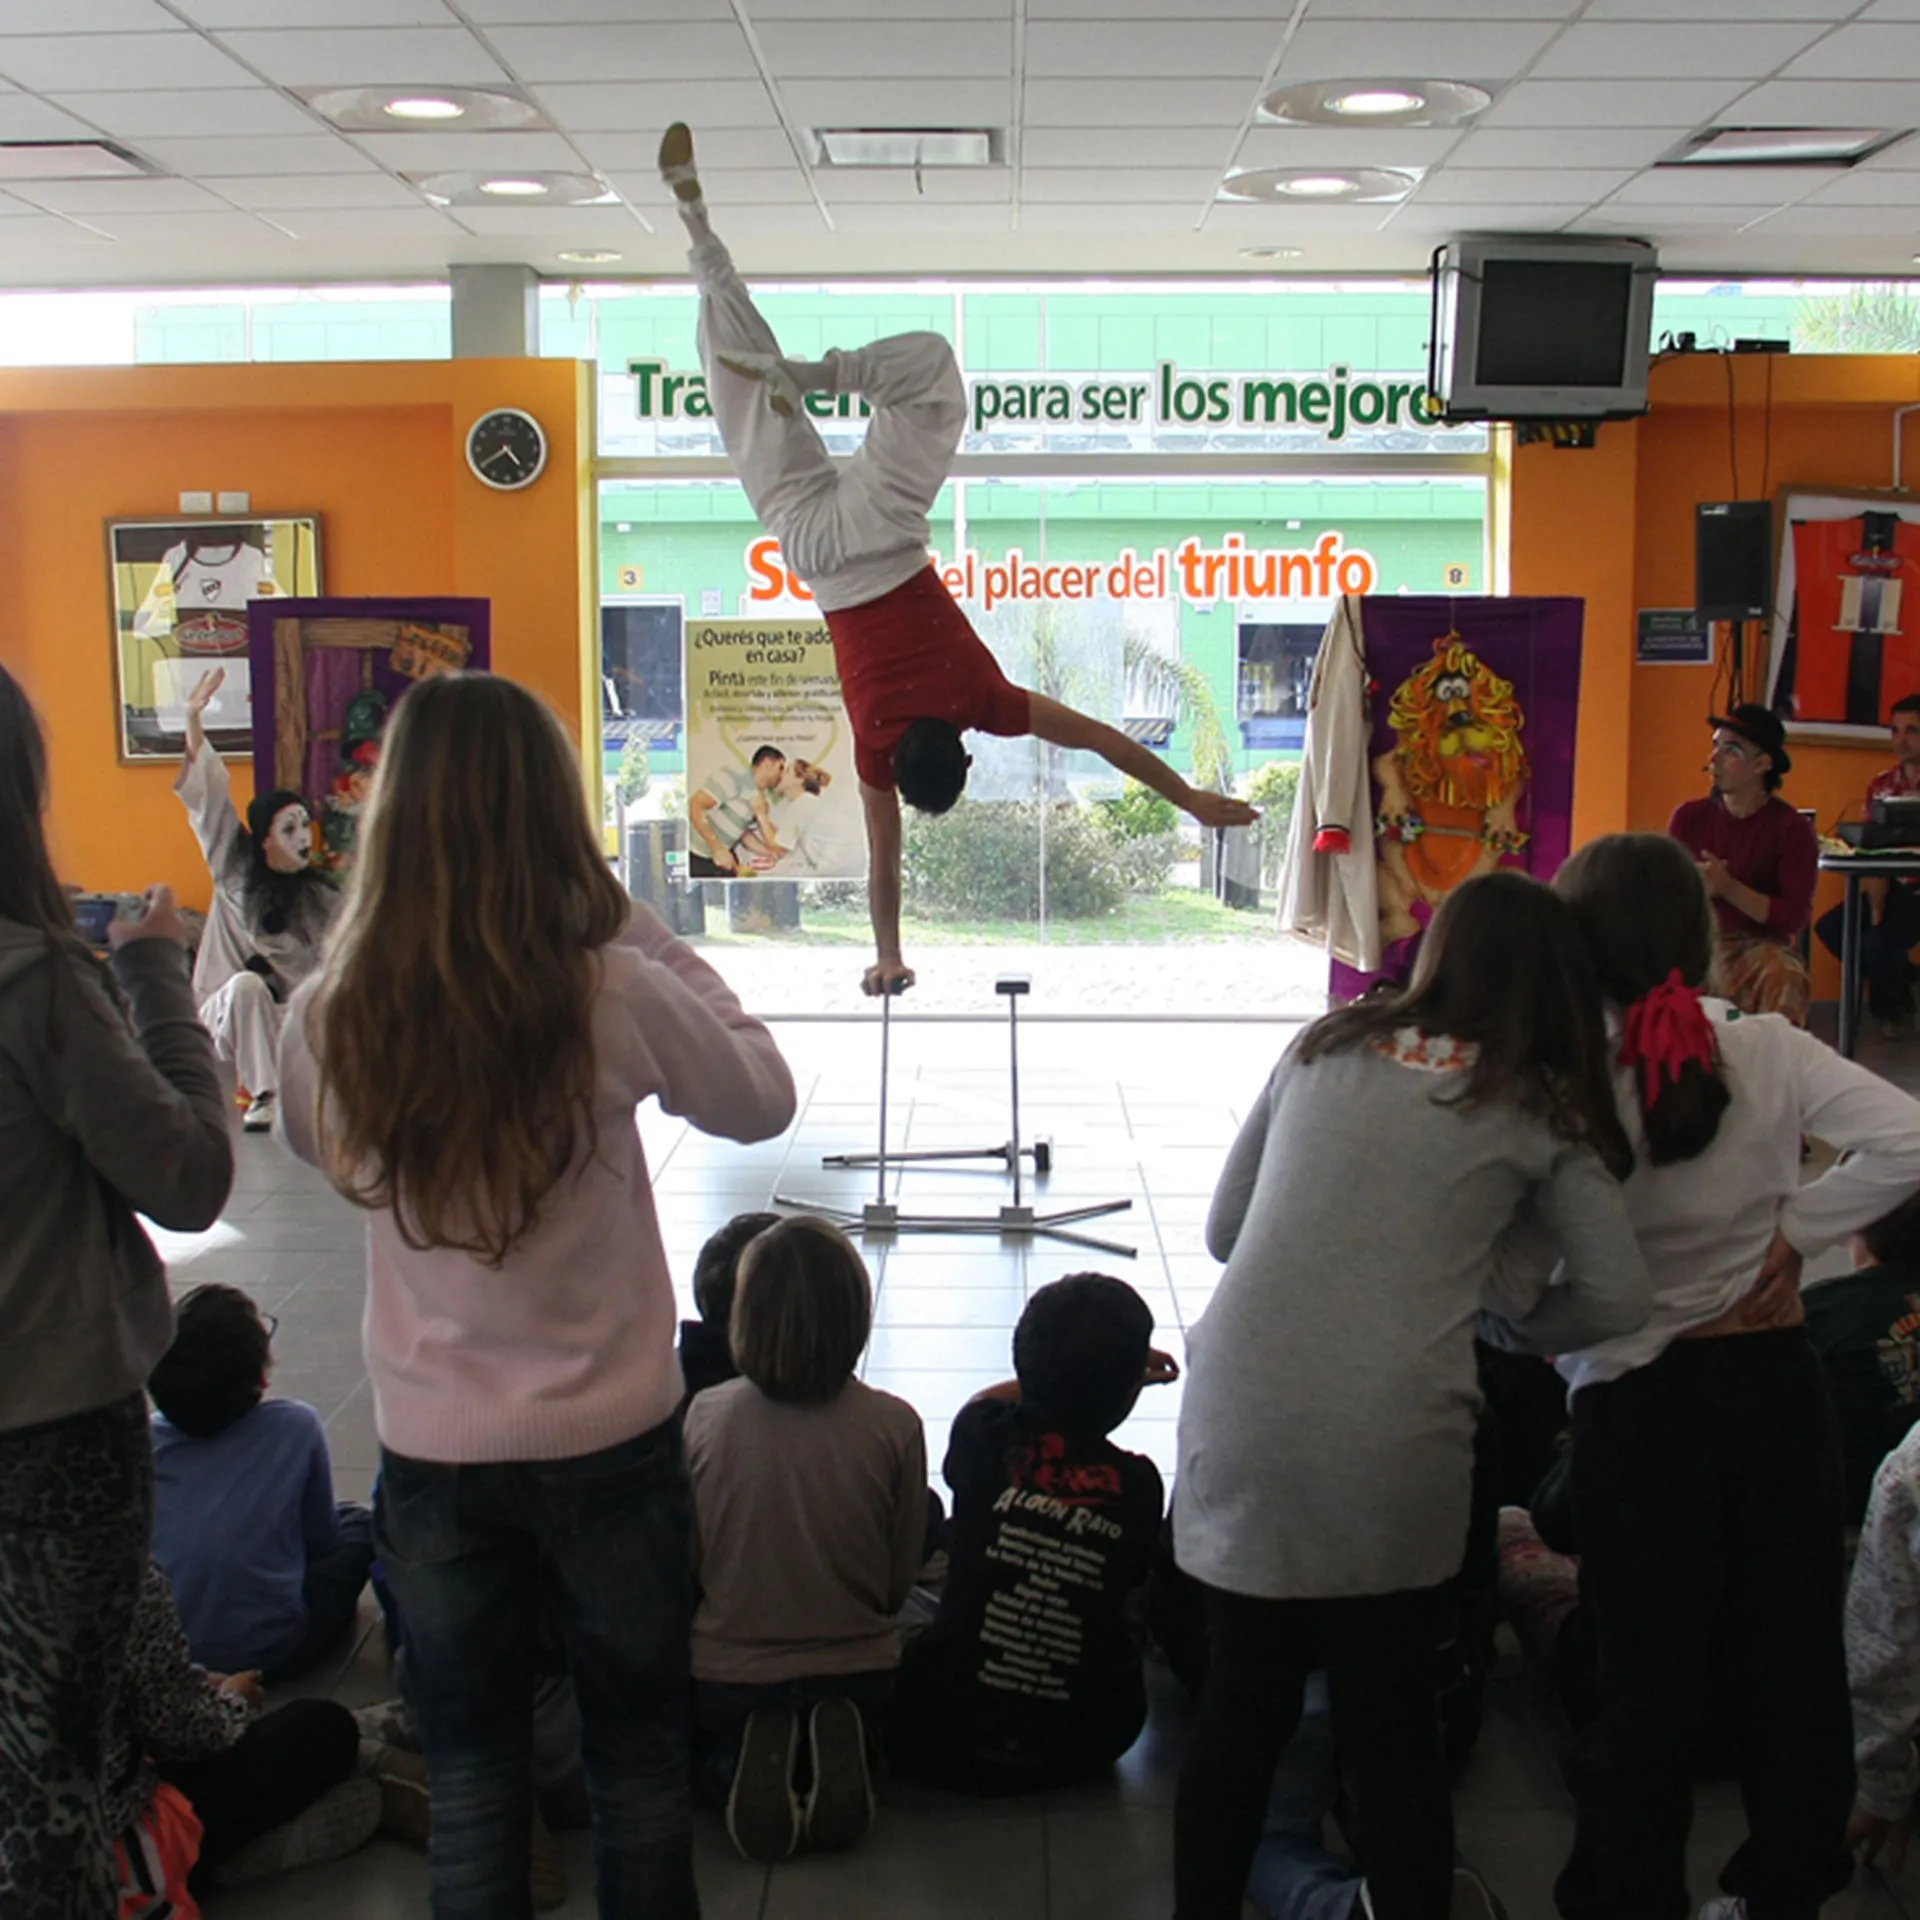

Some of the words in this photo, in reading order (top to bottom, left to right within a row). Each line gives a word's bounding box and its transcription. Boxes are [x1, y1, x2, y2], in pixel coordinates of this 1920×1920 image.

[976, 384, 1070, 429] para
[1084, 385, 1146, 417] ser
[1162, 363, 1230, 421] los
[1246, 366, 1455, 439] mejore
[623, 569, 636, 586] 3
[986, 553, 1100, 609] placer
[1108, 554, 1165, 599] del
[1178, 536, 1372, 598] triunfo
[756, 632, 784, 648] que
[787, 629, 802, 645] te
[745, 649, 764, 664] en
[767, 647, 806, 664] casa?
